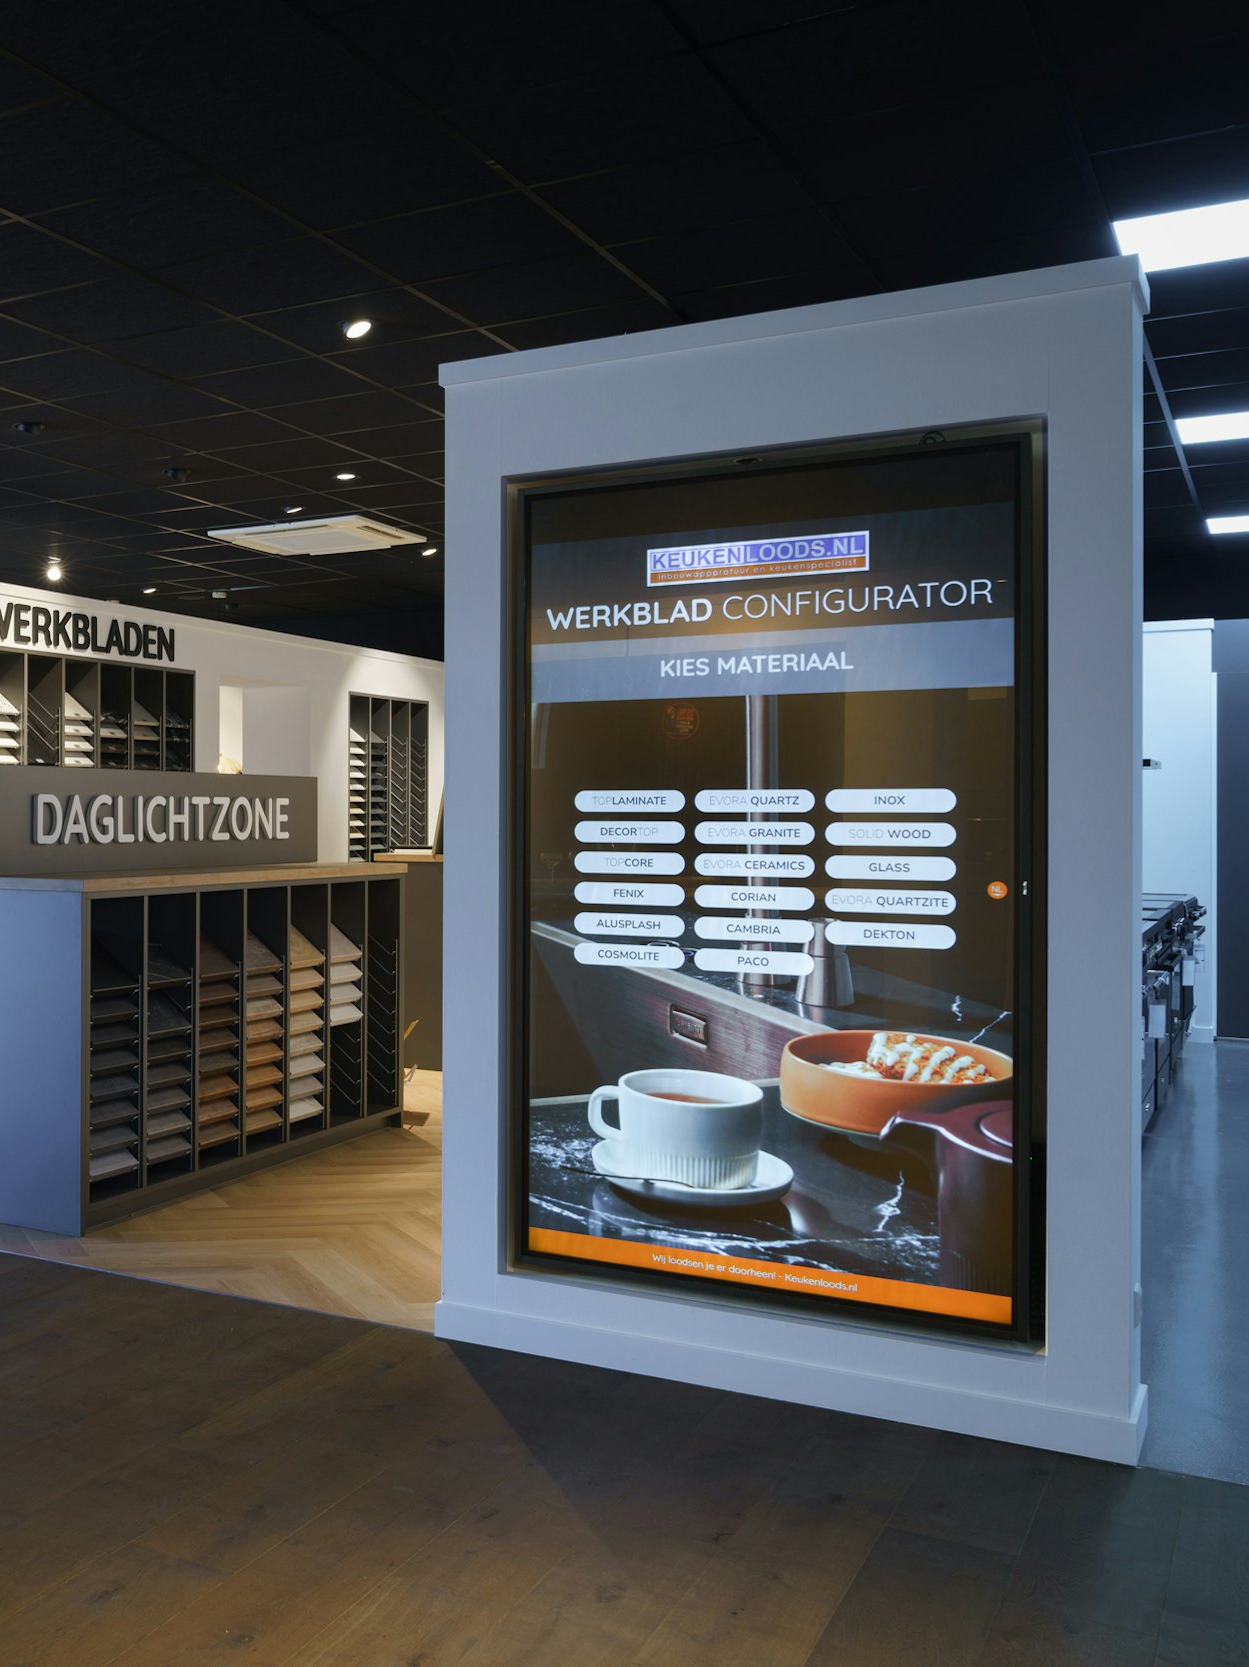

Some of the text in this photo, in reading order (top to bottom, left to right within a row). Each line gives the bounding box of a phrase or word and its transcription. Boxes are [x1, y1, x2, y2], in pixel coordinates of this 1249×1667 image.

[652, 537, 864, 570] KEUKENLOODS.NL
[770, 558, 858, 572] keukenspecialist
[546, 578, 994, 631] WERKBLAD CONFIGURATOR
[660, 651, 854, 678] KIES MATERIAAL
[709, 796, 800, 807] EVORA QUARTZ
[874, 795, 905, 805] INOX
[33, 794, 290, 844] DAGLICHTZONE
[708, 828, 801, 838] EVORA GRANITE
[848, 829, 932, 839] SOLID WOOD
[703, 860, 805, 871] EVORA CERAMICS
[868, 862, 910, 872] GLASS
[613, 888, 644, 898] FENIX
[731, 892, 776, 902] CORIAN
[832, 895, 949, 908] EVORA QUARTZITE
[596, 919, 661, 930] ALUSPLASH
[726, 924, 781, 935] CAMBRIA
[863, 929, 915, 940] DEKTON
[597, 949, 660, 961] COSMOLITE
[737, 956, 770, 967] PACO
[652, 1253, 666, 1265] Wij
[668, 1255, 704, 1269] loodsen
[705, 1262, 715, 1271] je
[716, 1264, 727, 1272] er
[728, 1265, 776, 1280] doorheen!
[784, 1273, 858, 1292] Keukenloods.nl
